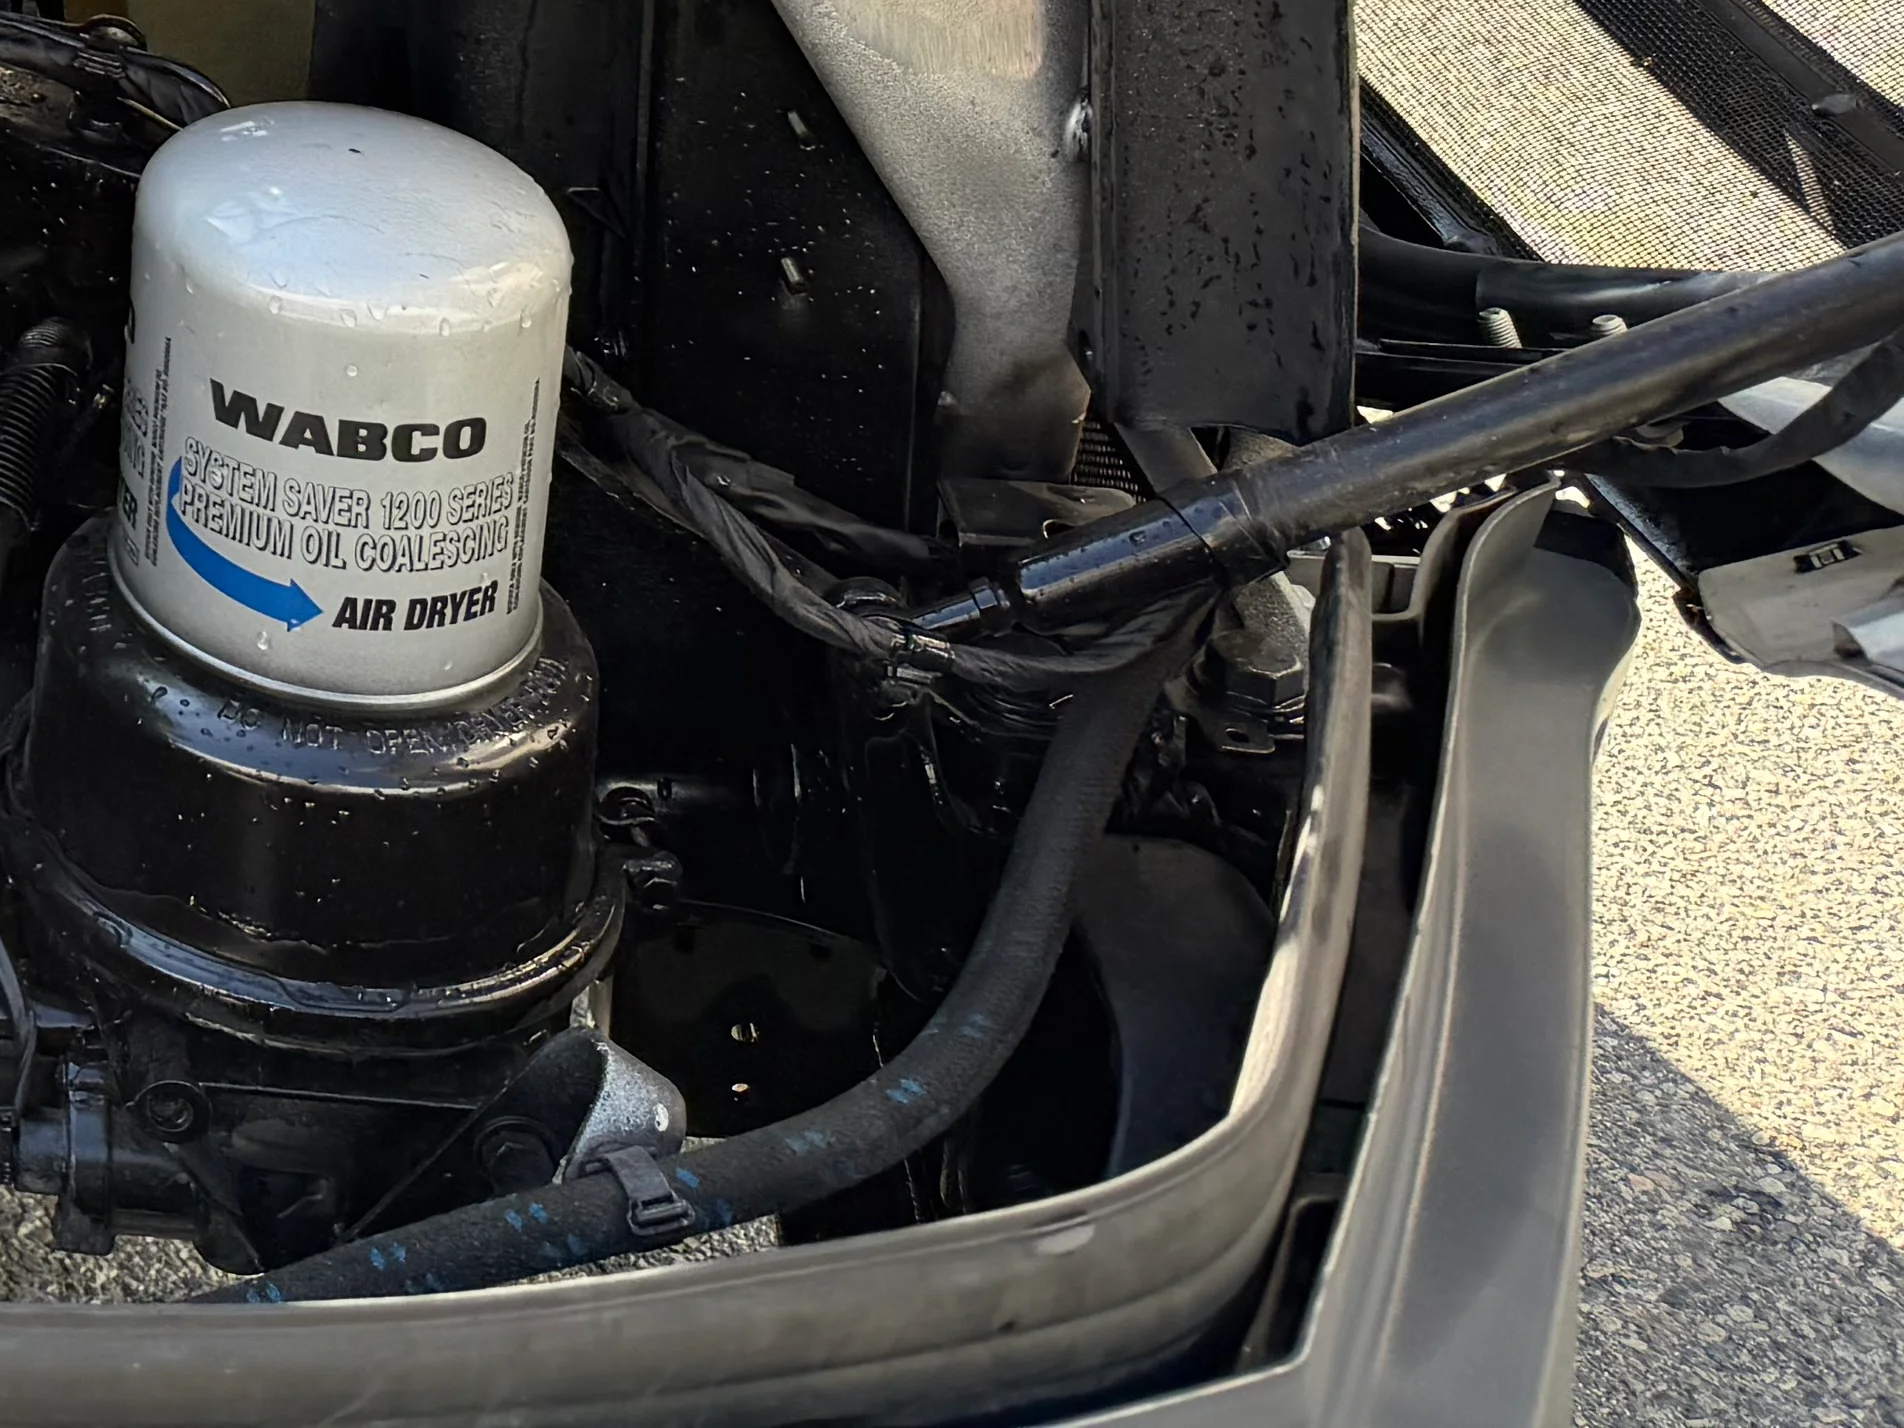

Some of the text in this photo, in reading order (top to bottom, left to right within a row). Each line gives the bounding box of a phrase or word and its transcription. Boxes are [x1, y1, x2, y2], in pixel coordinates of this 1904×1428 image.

[210, 377, 487, 463] WABCO
[180, 474, 293, 560] PREMIUM
[300, 525, 348, 570] OIL
[354, 515, 510, 573] COALESCING
[184, 436, 277, 514] SYSTEM
[282, 478, 371, 529] SAVER
[380, 489, 441, 530] 1200
[446, 471, 515, 525] SERIES
[331, 580, 499, 631] AIR DRYER
